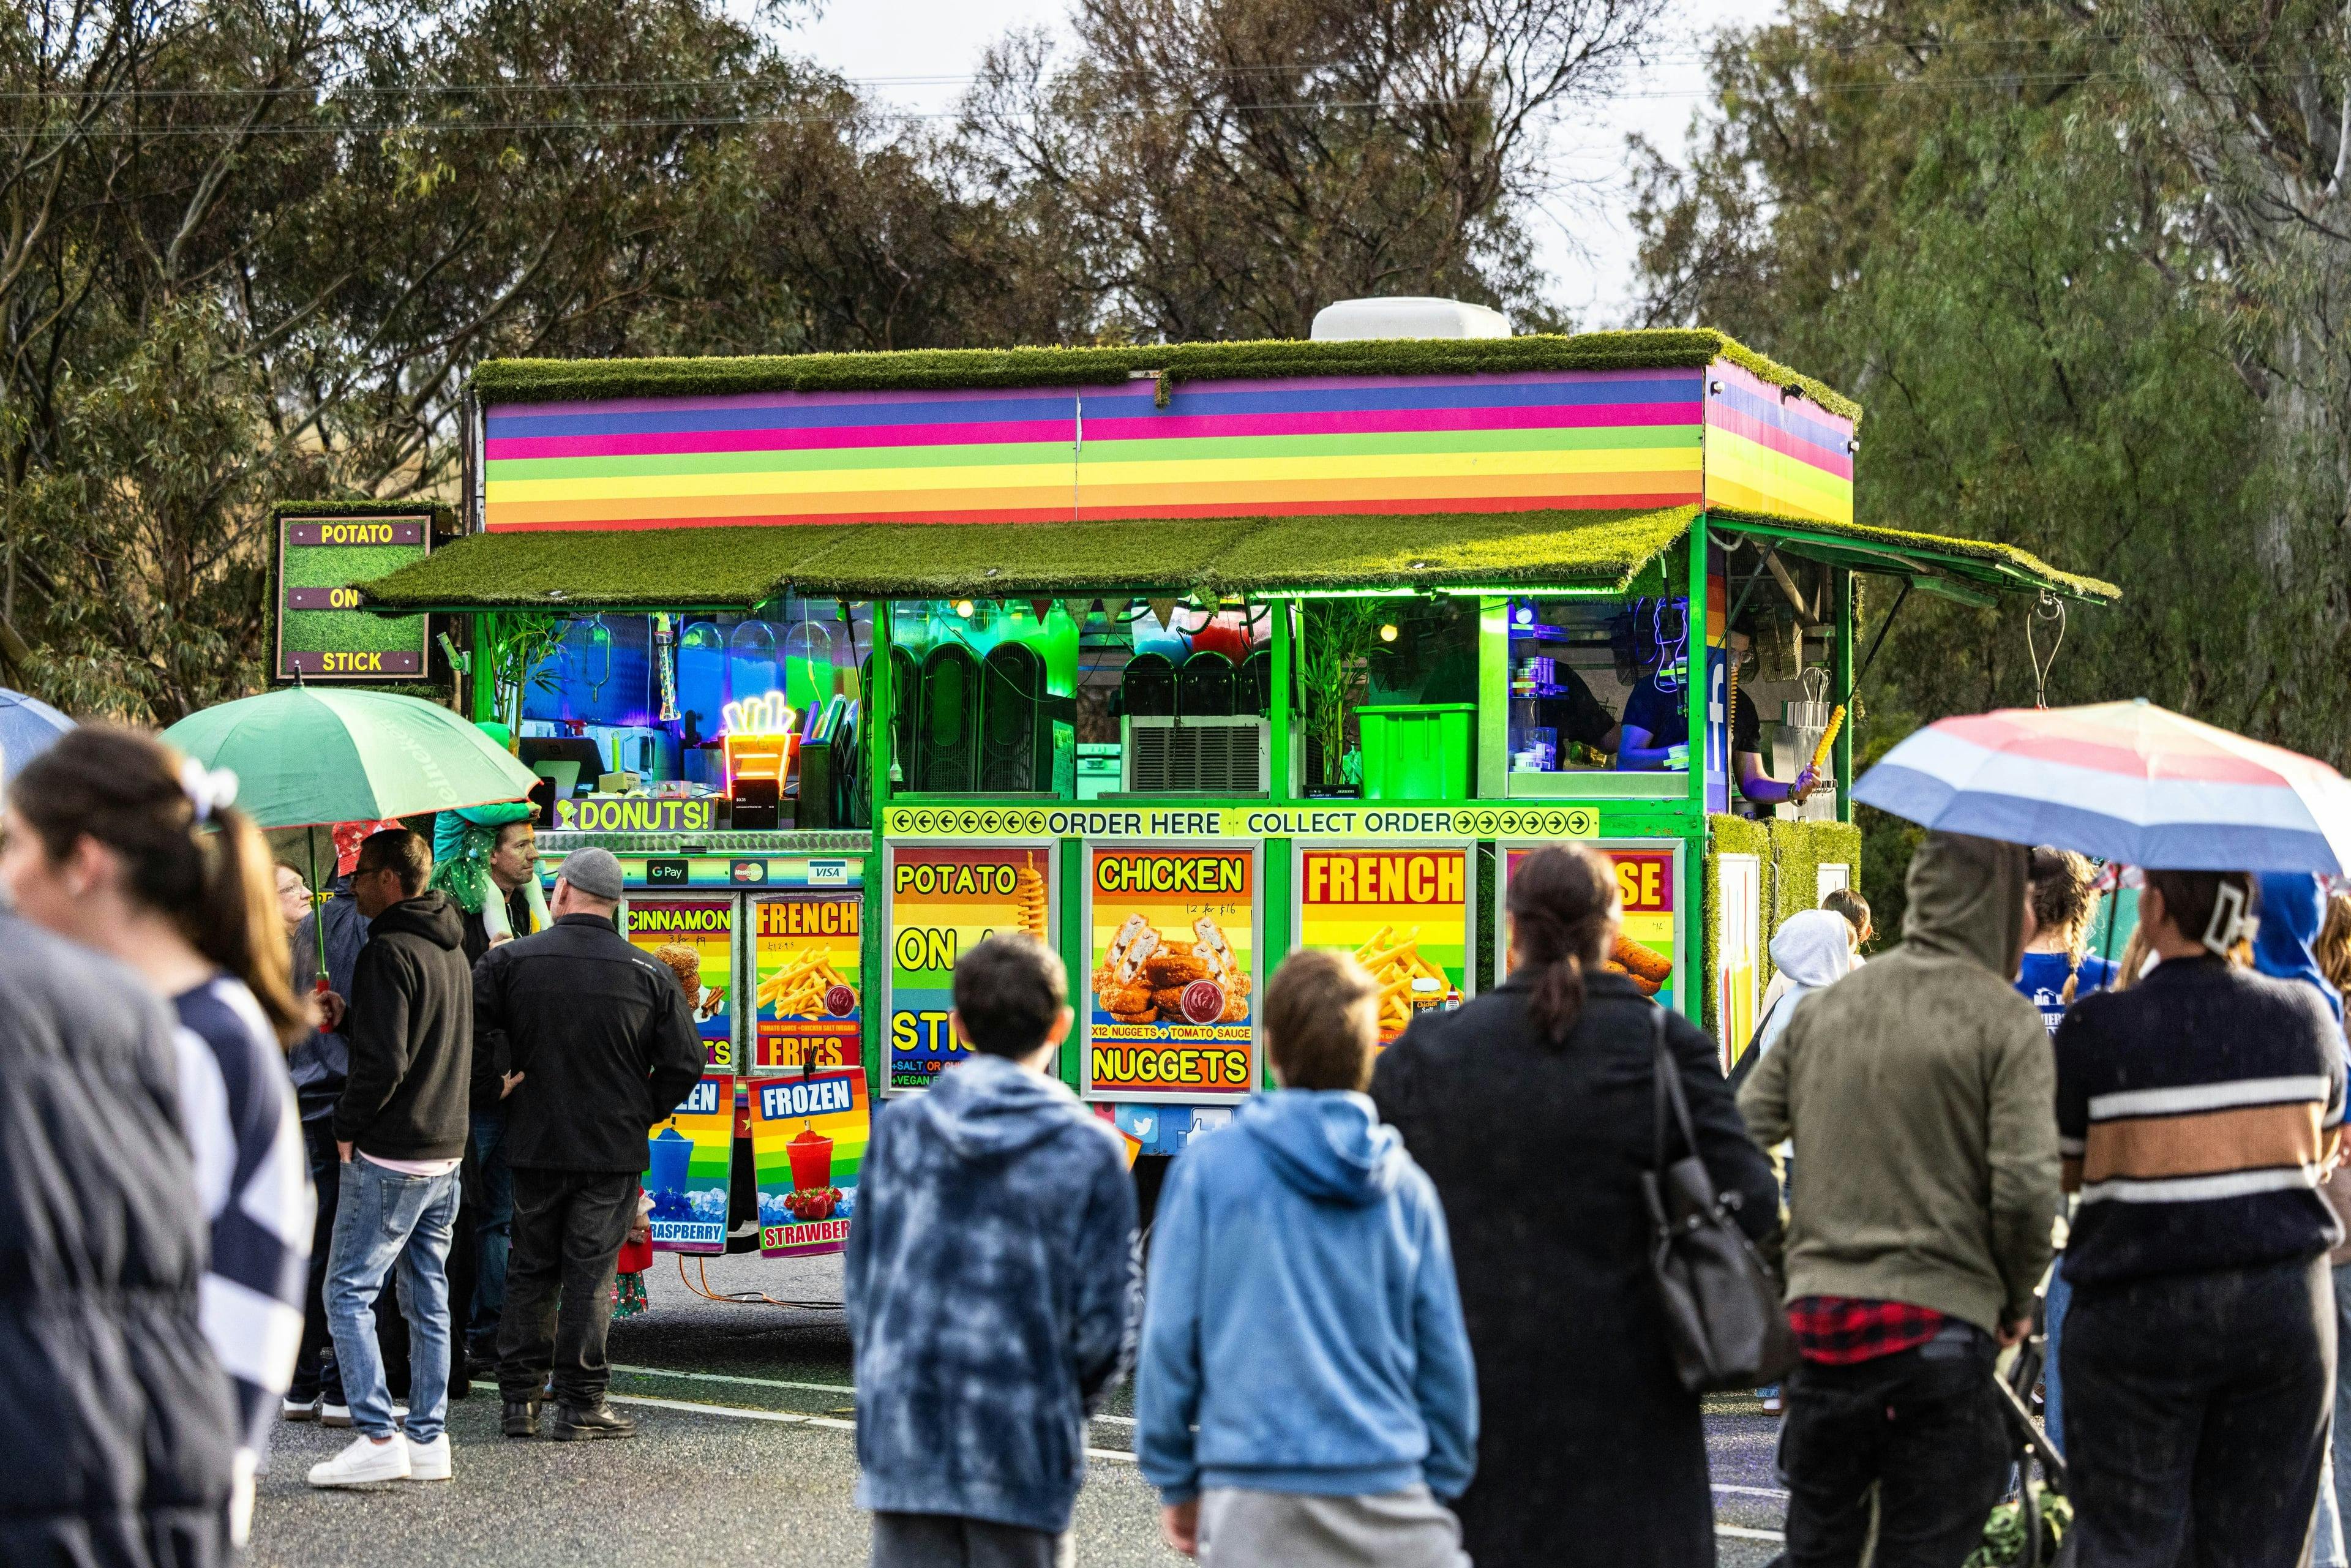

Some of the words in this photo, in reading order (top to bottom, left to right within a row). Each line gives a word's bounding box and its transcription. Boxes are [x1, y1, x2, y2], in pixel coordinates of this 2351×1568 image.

[321, 525, 393, 544] POTATO
[330, 589, 358, 608] ON
[323, 652, 382, 672] STICK
[376, 718, 462, 805] eineken
[580, 801, 710, 831] DONUTS!
[1048, 812, 1142, 835] ORDER
[1152, 812, 1220, 835] HERE
[1248, 812, 1357, 833] COLLECT
[1365, 812, 1452, 833] ORDER
[665, 867, 682, 879] Pay
[816, 868, 840, 877] VISA
[896, 864, 1017, 895] POTATO
[1098, 858, 1244, 892] CHICKEN
[1309, 856, 1464, 902] FRENCH
[628, 909, 731, 931] CINNAMON
[757, 902, 859, 935] FRENCH
[1187, 904, 1197, 914] 12
[1202, 902, 1215, 914] for
[1220, 903, 1236, 916] $16
[669, 935, 674, 943] 3
[677, 934, 690, 945] for
[696, 936, 706, 947] $9
[896, 928, 957, 971] ON
[1092, 1027, 1108, 1037] X12
[1112, 1027, 1157, 1037] NUGGETS
[1170, 1027, 1213, 1038] TOMATO
[1218, 1027, 1251, 1038] SAUCE
[769, 1037, 843, 1066] FRIES
[927, 1061, 941, 1071] OR
[1092, 1048, 1248, 1082] NUGGETS
[763, 1081, 850, 1117] FROZEN
[651, 1224, 721, 1240] RASPBERRY
[764, 1219, 850, 1247] STRAWBER
